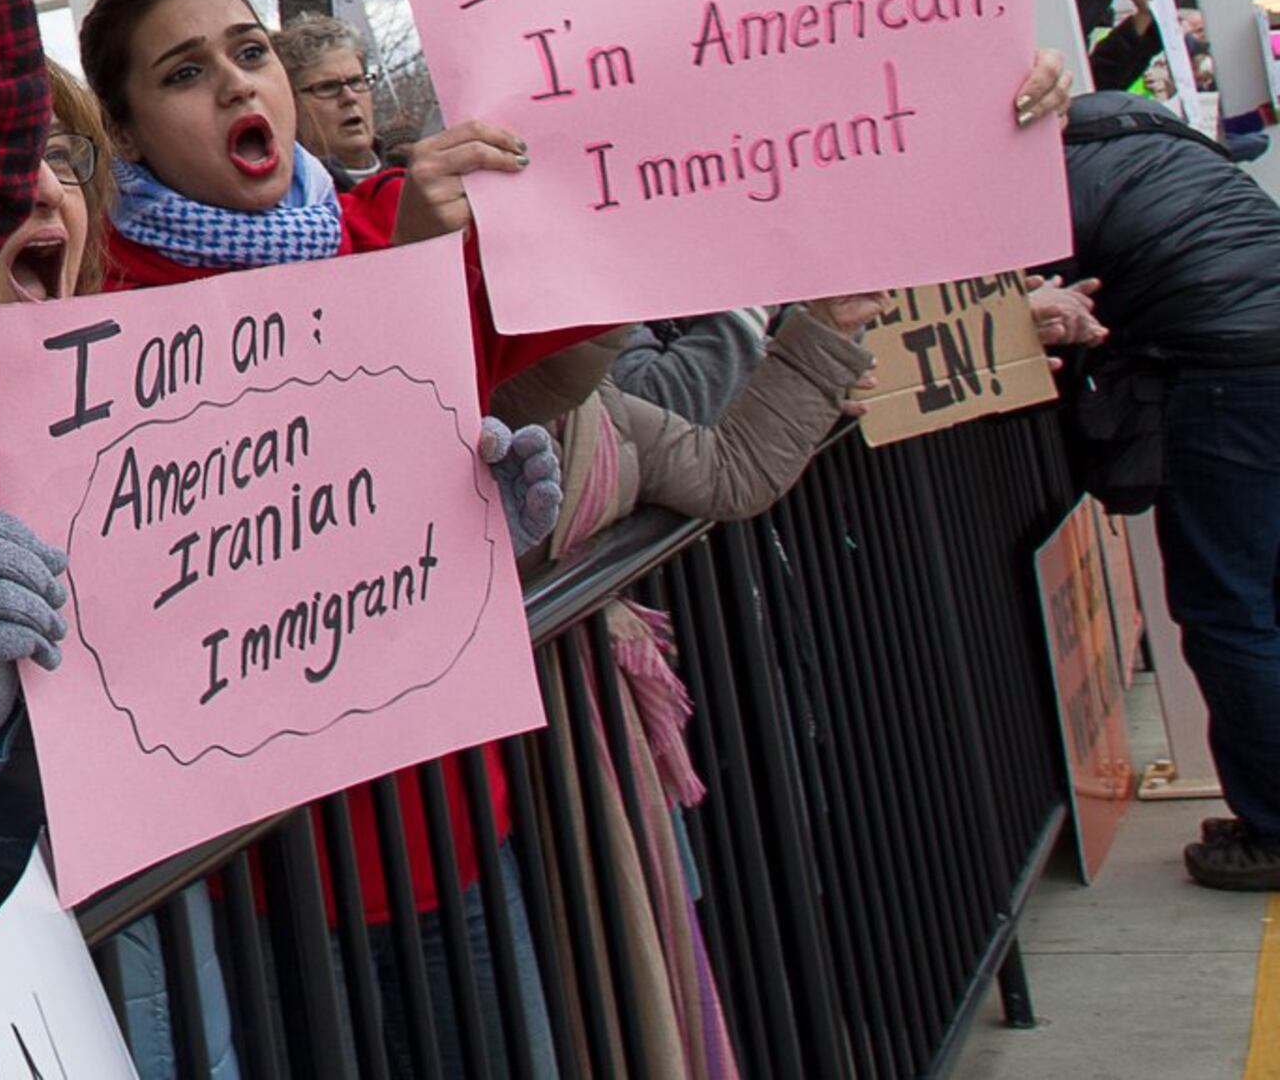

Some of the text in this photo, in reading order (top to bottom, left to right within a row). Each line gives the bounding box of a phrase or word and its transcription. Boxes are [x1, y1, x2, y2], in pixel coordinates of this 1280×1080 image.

[522, 20, 637, 103] I'm
[584, 60, 917, 211] Immigrant
[42, 319, 121, 438] I
[135, 323, 203, 408] am
[901, 311, 1003, 414] IN!
[102, 416, 311, 538] American
[154, 467, 377, 610] Iranian
[200, 522, 438, 706] Immigrant
